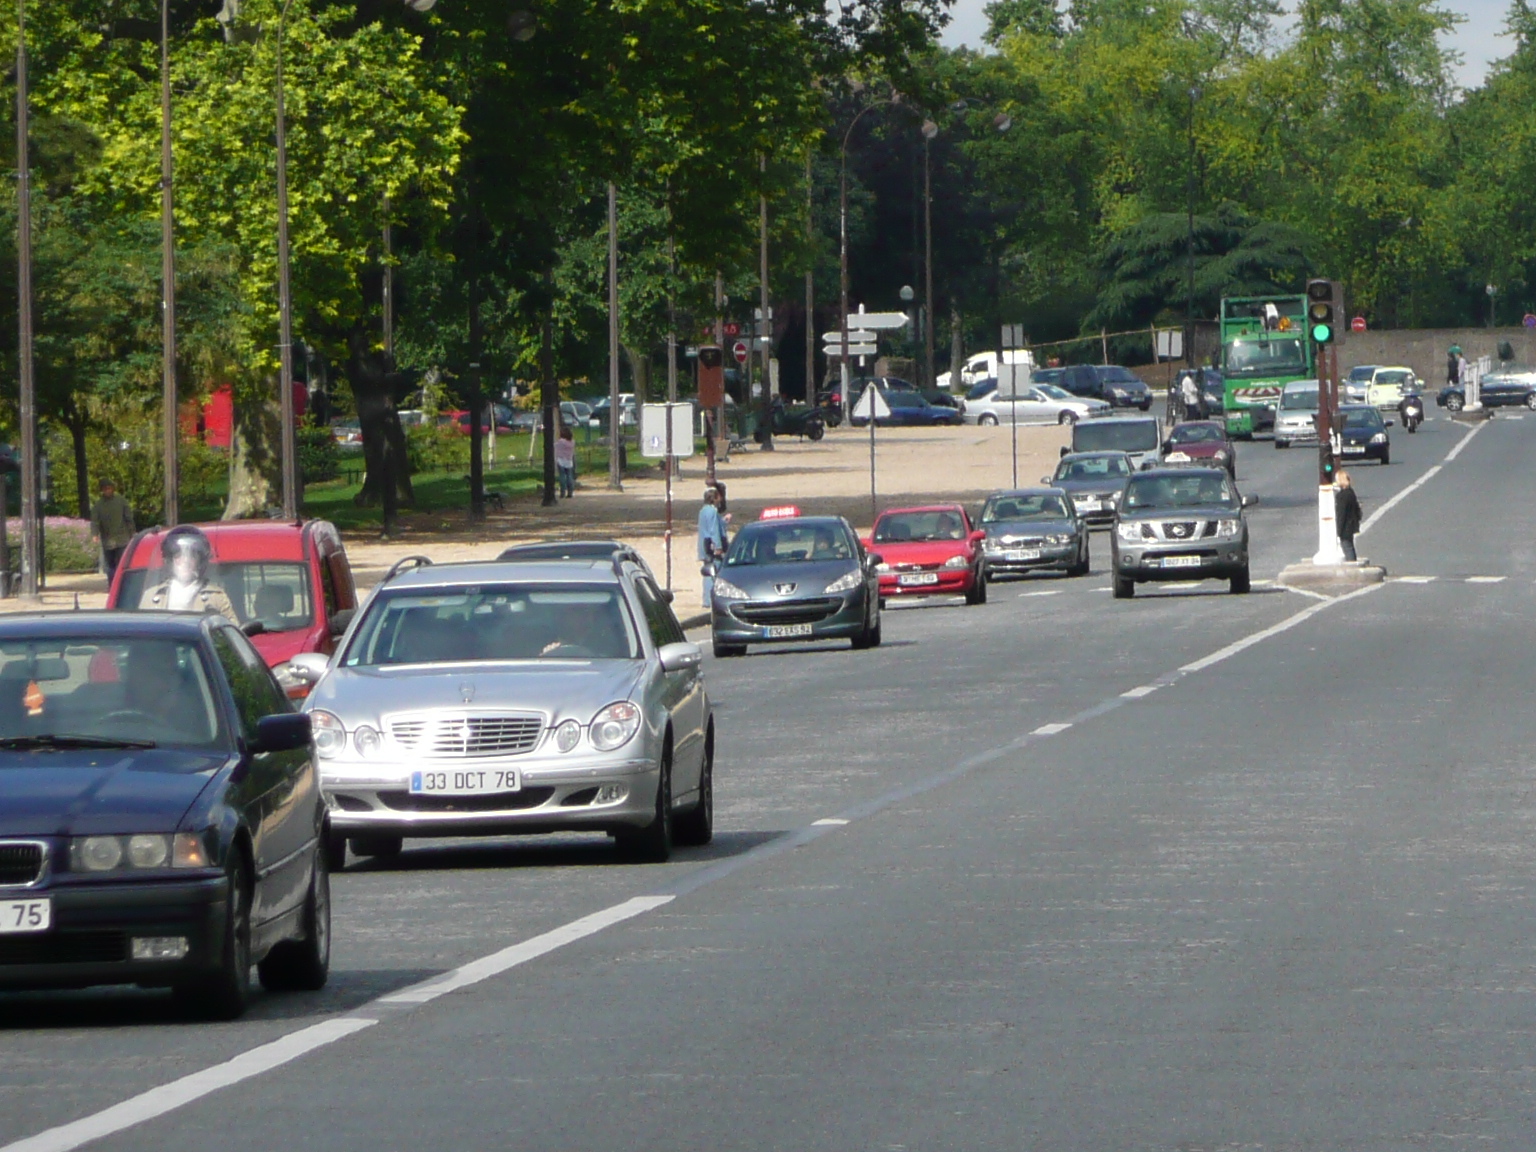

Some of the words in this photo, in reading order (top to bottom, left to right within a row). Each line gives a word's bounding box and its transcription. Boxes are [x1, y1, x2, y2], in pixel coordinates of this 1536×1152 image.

[425, 773, 447, 790] 33
[454, 771, 486, 789] DCT
[494, 770, 516, 788] 78
[11, 903, 43, 927] 75
